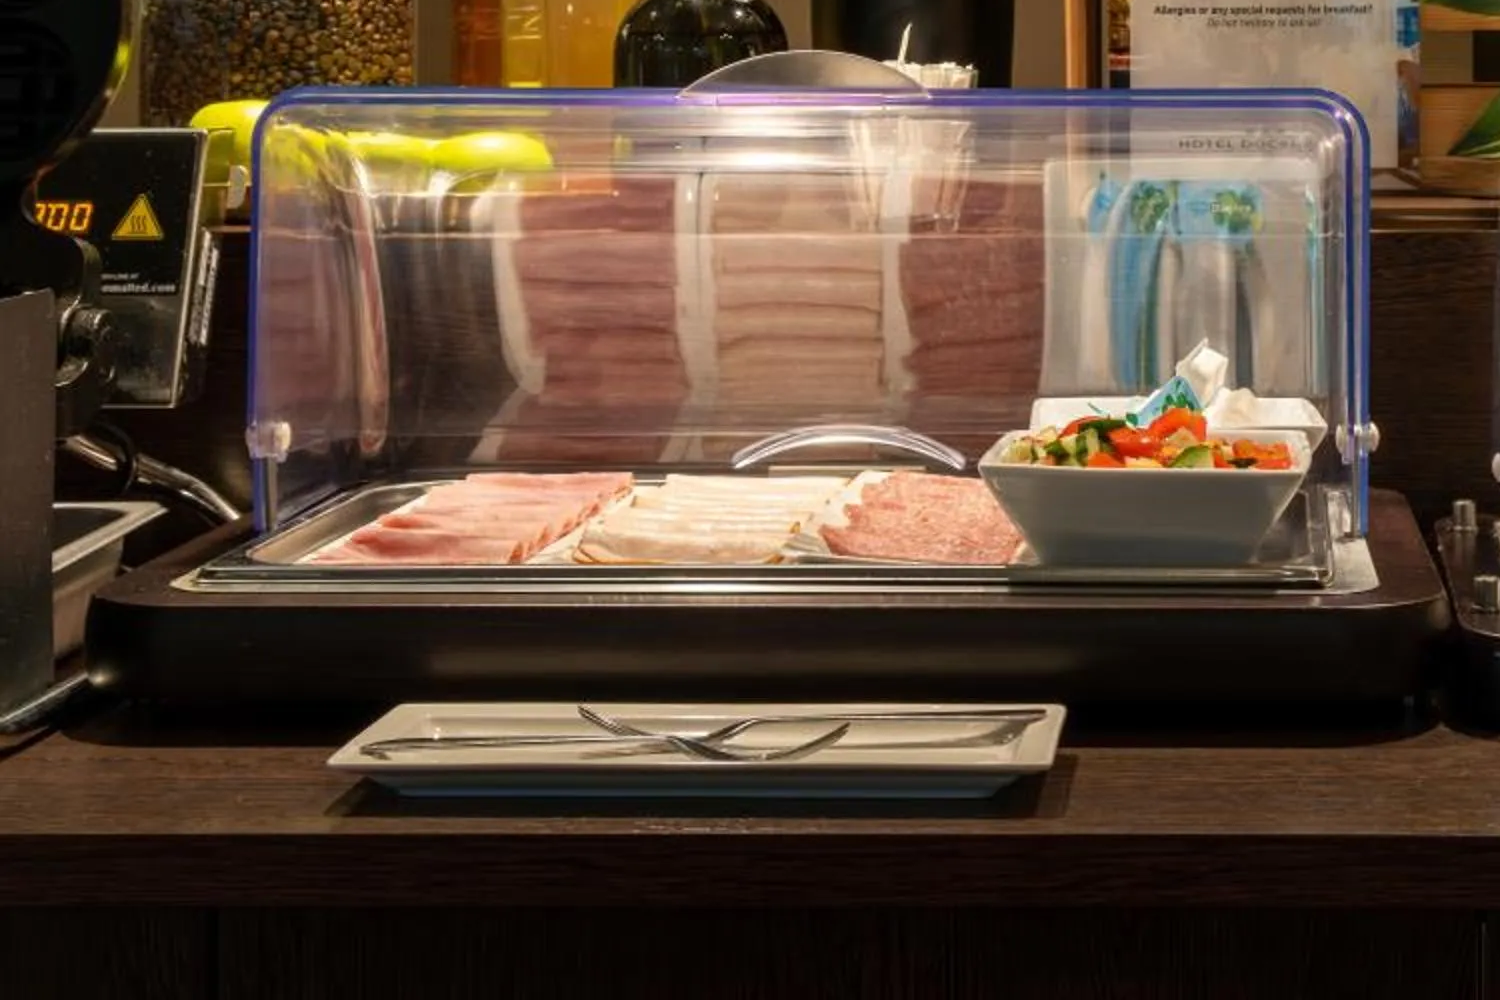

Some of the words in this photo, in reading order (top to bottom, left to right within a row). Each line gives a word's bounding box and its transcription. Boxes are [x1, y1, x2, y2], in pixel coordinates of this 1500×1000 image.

[1154, 5, 1196, 17] Allergies
[1198, 7, 1209, 15] or
[1211, 7, 1228, 17] any
[1229, 5, 1263, 17] special
[1265, 5, 1305, 17] requests
[1307, 5, 1321, 15] for
[1323, 5, 1373, 15] breakfast?
